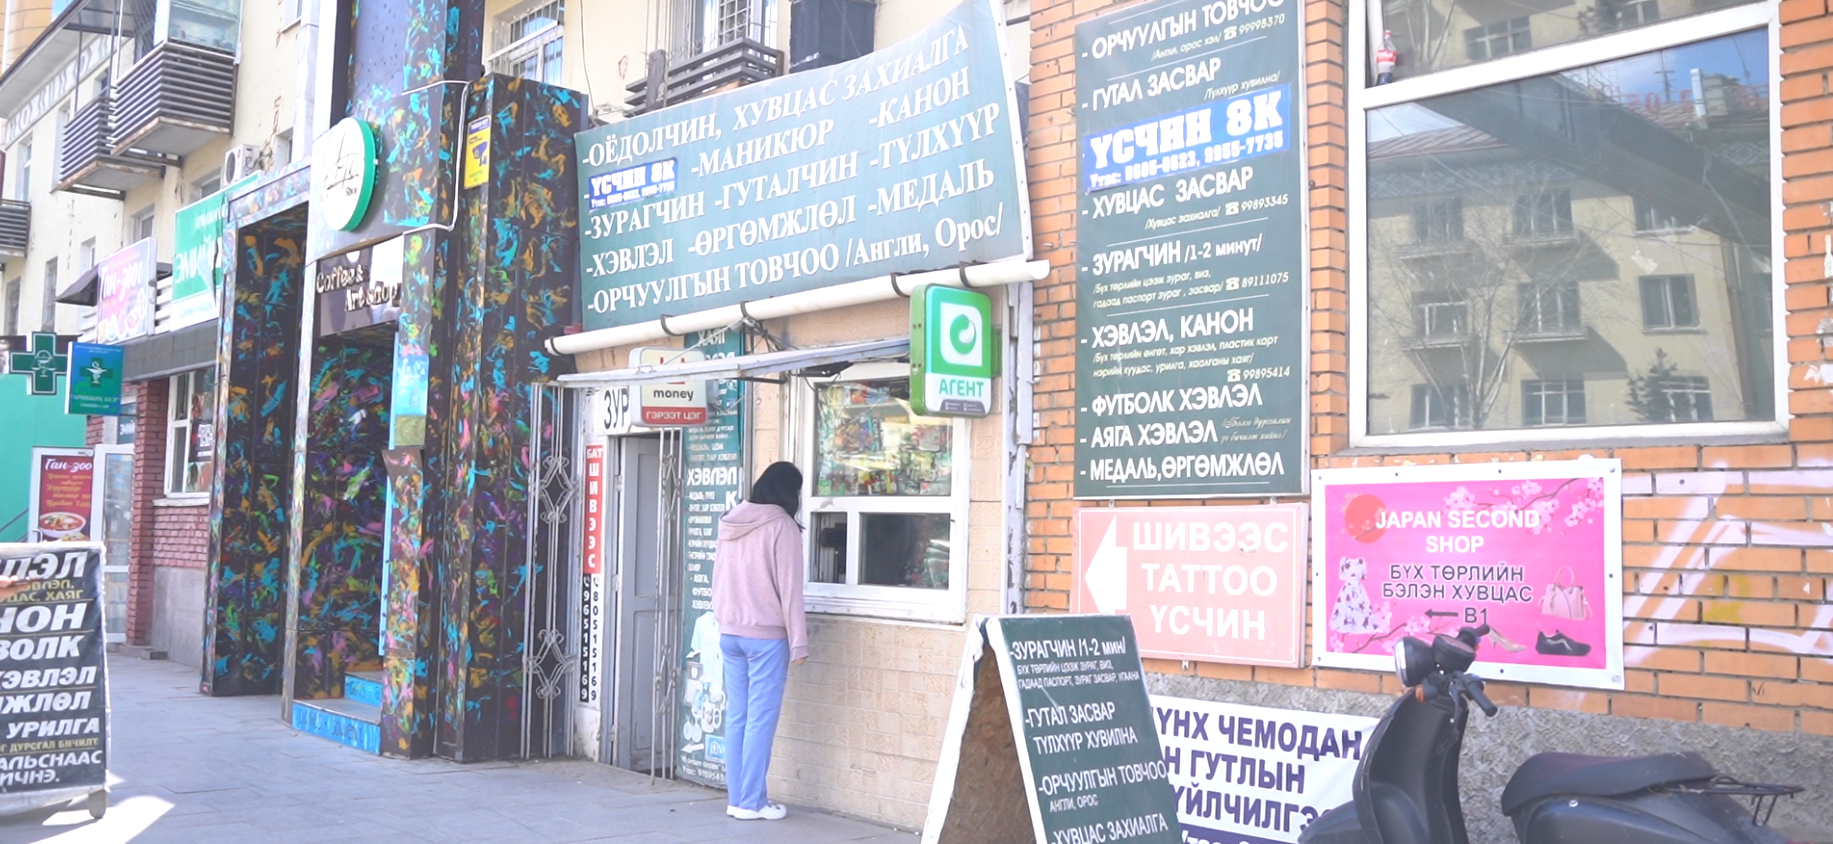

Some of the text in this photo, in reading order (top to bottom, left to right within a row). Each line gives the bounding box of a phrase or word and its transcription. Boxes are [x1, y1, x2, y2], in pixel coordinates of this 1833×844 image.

[1092, 10, 1196, 59] ОРЧУУЛГЫН
[1238, 13, 1285, 35] 99998370
[582, 25, 969, 167] -ОЁДОЛЧИН, ХУВЦАС ЗАХИАЛГА
[1092, 57, 1222, 111] ГУТАЛ ЗАСВАР
[690, 67, 970, 178] -МАНИКЮР -КАНОН
[1090, 108, 1212, 170] ҮСЧИН
[584, 191, 705, 239] -ЗУРАГЧИН
[714, 151, 858, 210] -ГУТАЛЧИН
[870, 102, 1000, 170] -ТҮЛХҮҮР
[1092, 166, 1254, 219] ХУВЦАС ЗАСВАР
[1240, 194, 1289, 212] 99893345
[586, 158, 995, 277] -ХЭВЛЭЛ -ӨРГӨМЖЛӨЛ -МЕДАЛЬ
[587, 202, 1004, 313] -ОРЧУУЛГЫН ТОВЧОО /Англи, Орос/
[1092, 240, 1181, 276] ЗУРАГЧИН
[316, 265, 355, 293] Coffee
[1241, 271, 1290, 288] 89111075
[1091, 307, 1254, 349] ХЭВЛЭЛ, КАНОН
[1242, 365, 1291, 381] 99895414
[653, 389, 694, 402] money
[938, 378, 985, 397] АГЕНТ
[1091, 382, 1263, 417] ФУТБОЛК ХЭВЛЭЛ
[646, 411, 702, 421] ГЭРЭЭТ ЦЭГ
[1090, 425, 1134, 448] АЯГА
[1138, 420, 1219, 446] ХЭВЛЭЛ
[586, 448, 603, 459] БАТ
[687, 466, 738, 486] ХЭВЛЭЛ
[1375, 510, 1541, 529] JAPAN SECOND
[1133, 521, 1289, 553] ШИВЭЭС
[1426, 535, 1484, 553] SHOP
[1141, 563, 1278, 597] TATTOO
[1390, 562, 1524, 582] БҮХ ТӨРЛИЙН
[1383, 583, 1533, 604] БЭЛЭН ХУВЦАС
[1149, 604, 1265, 640] ҮСЧИН
[0, 666, 97, 689] ЭВЛЭЛ
[0, 691, 91, 714] ЖЛӨЛ
[1069, 701, 1116, 723] ЗАСВАР
[6, 717, 100, 739] УРИЛГА
[1033, 726, 1139, 755] ТҮЛХҮҮР ХУВИЛНА
[1150, 706, 1363, 761] ҮНХ ЧЕМОДАН
[1117, 760, 1168, 785] ТОВЧОО
[1190, 750, 1306, 794] ГУТЛЫН
[1106, 813, 1169, 841] ЗАХИАЛГА
